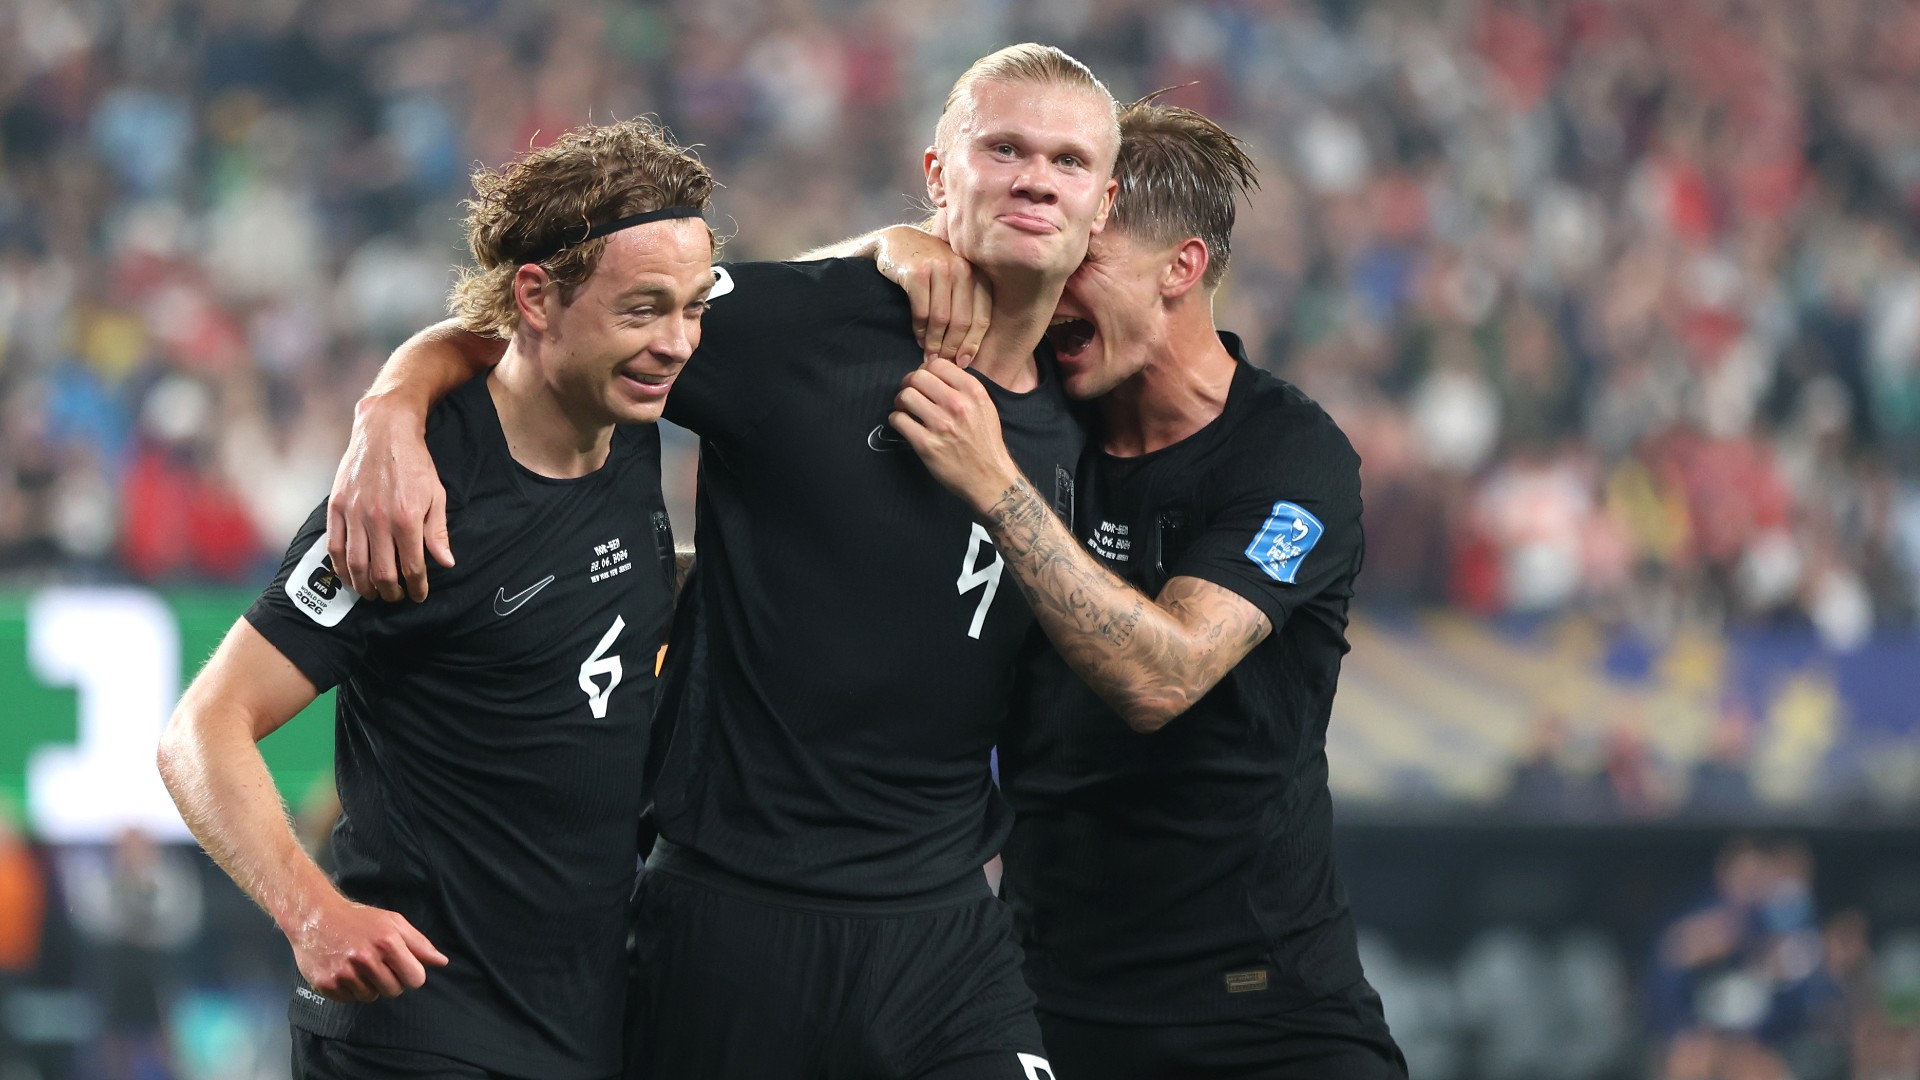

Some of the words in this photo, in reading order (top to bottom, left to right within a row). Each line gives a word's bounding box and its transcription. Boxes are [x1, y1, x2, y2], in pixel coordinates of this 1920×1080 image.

[313, 581, 328, 595] FIFA
[957, 522, 1004, 639] 9
[295, 590, 324, 615] 2026
[301, 585, 317, 601] WORLD
[316, 597, 328, 608] CUP
[579, 614, 625, 718] 6
[296, 986, 325, 1006] AERO-FIT
